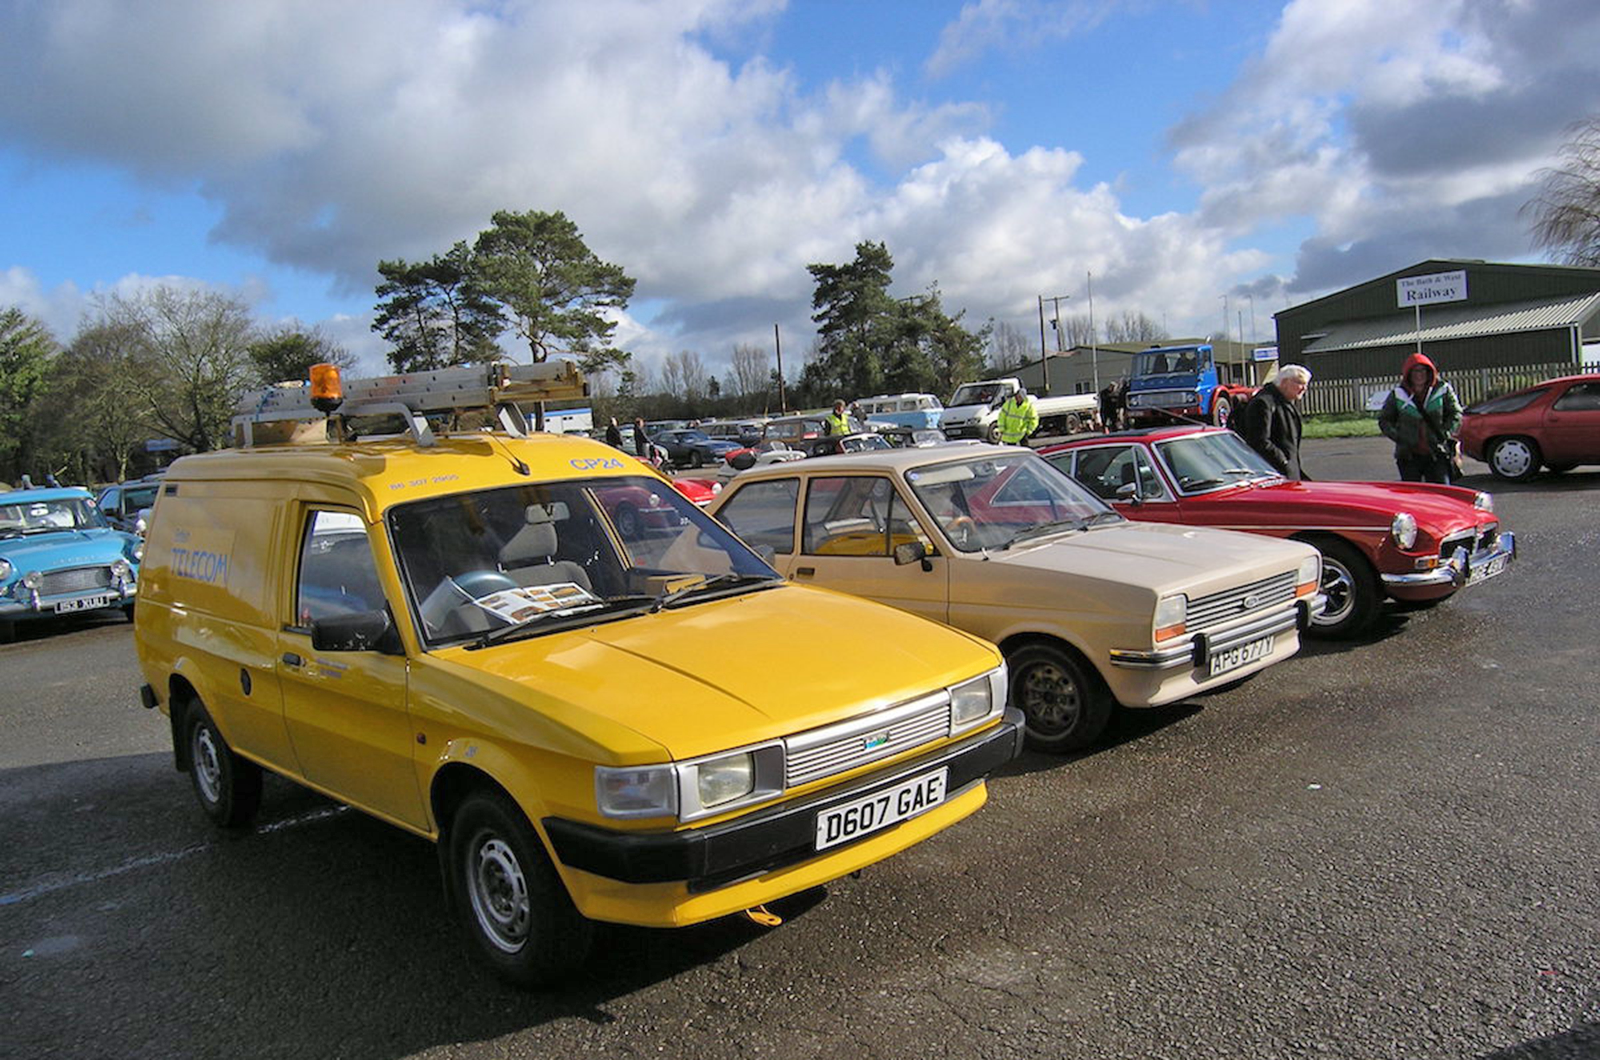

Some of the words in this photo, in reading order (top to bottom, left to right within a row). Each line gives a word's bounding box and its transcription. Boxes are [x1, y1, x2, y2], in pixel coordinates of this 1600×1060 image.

[1407, 287, 1456, 301] Railway
[570, 457, 625, 470] CP24
[170, 547, 229, 585] TELECOM
[1212, 647, 1239, 673] APG
[1241, 635, 1273, 661] 677Y
[825, 795, 892, 843] D607
[897, 776, 941, 817] GAE
